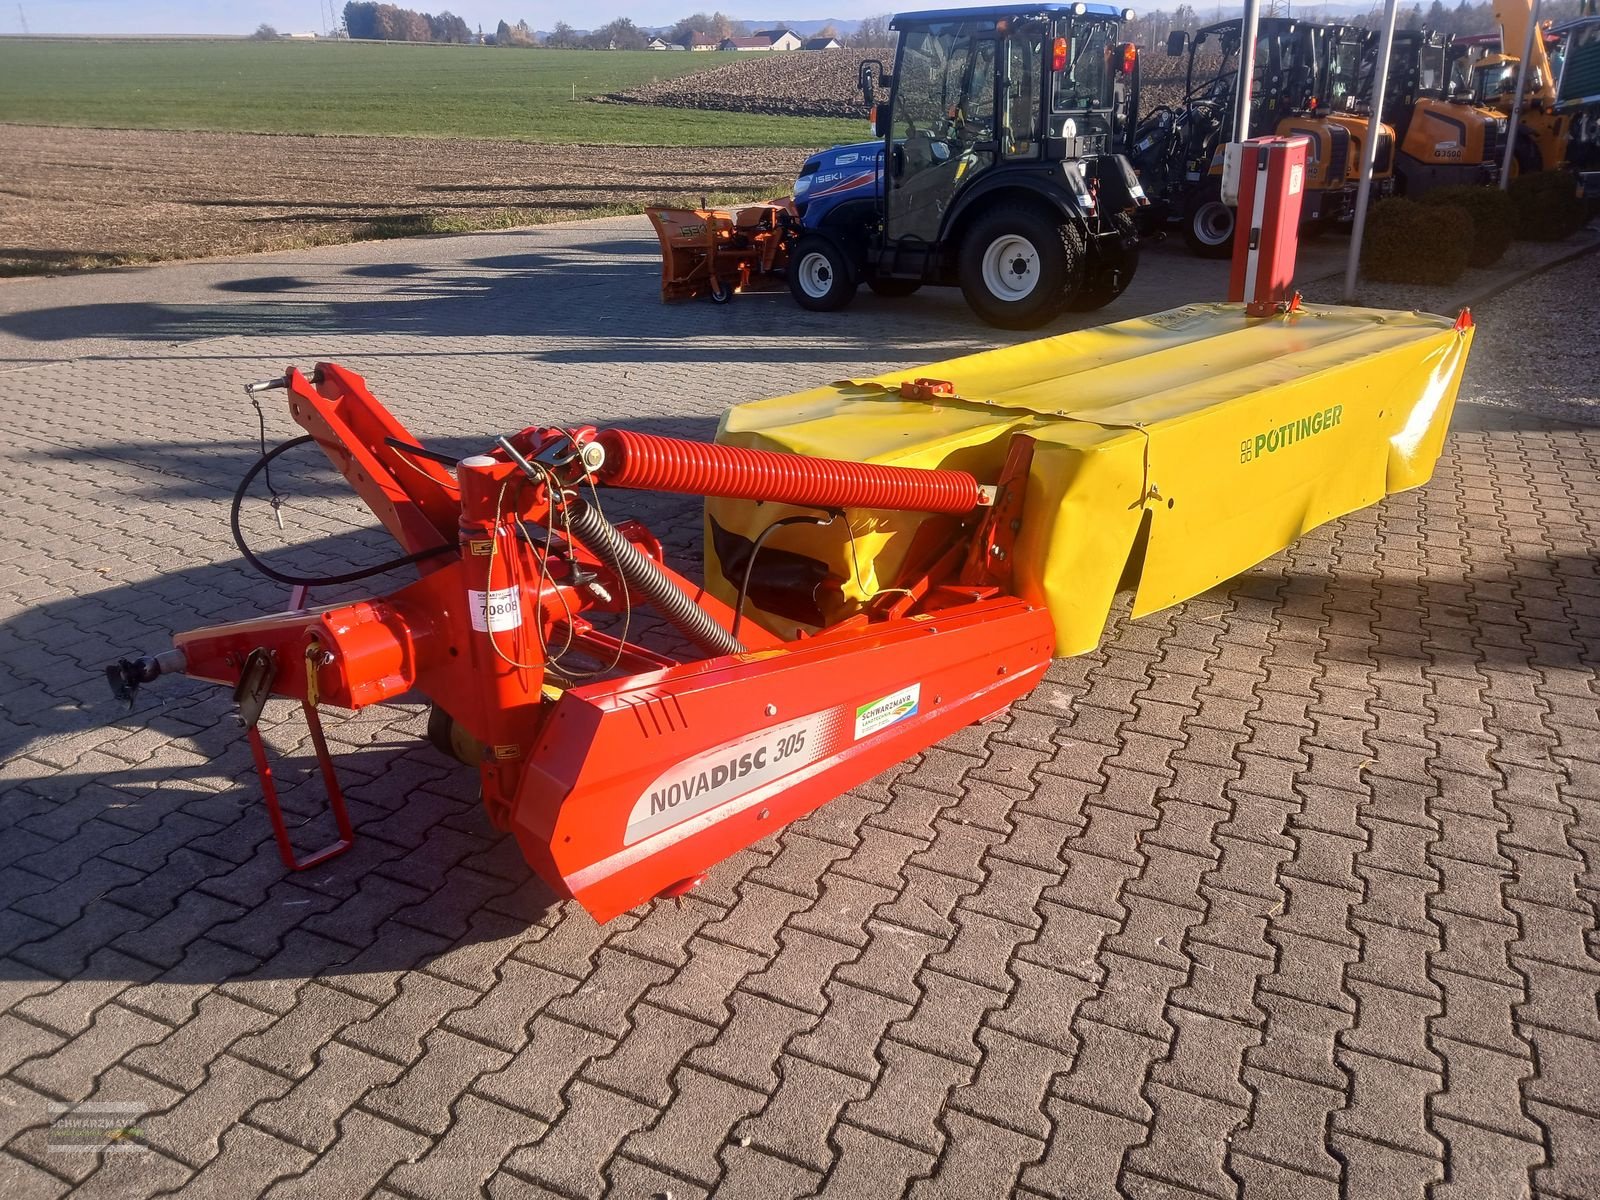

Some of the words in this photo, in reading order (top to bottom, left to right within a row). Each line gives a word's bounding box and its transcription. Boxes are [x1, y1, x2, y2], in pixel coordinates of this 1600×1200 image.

[815, 172, 843, 184] ISEKI
[1254, 404, 1343, 458] PÖTTINGER
[479, 600, 518, 616] 70808
[861, 694, 912, 721] SCHWARZMAYR
[650, 746, 767, 816] NOVADISC
[772, 729, 807, 763] 305
